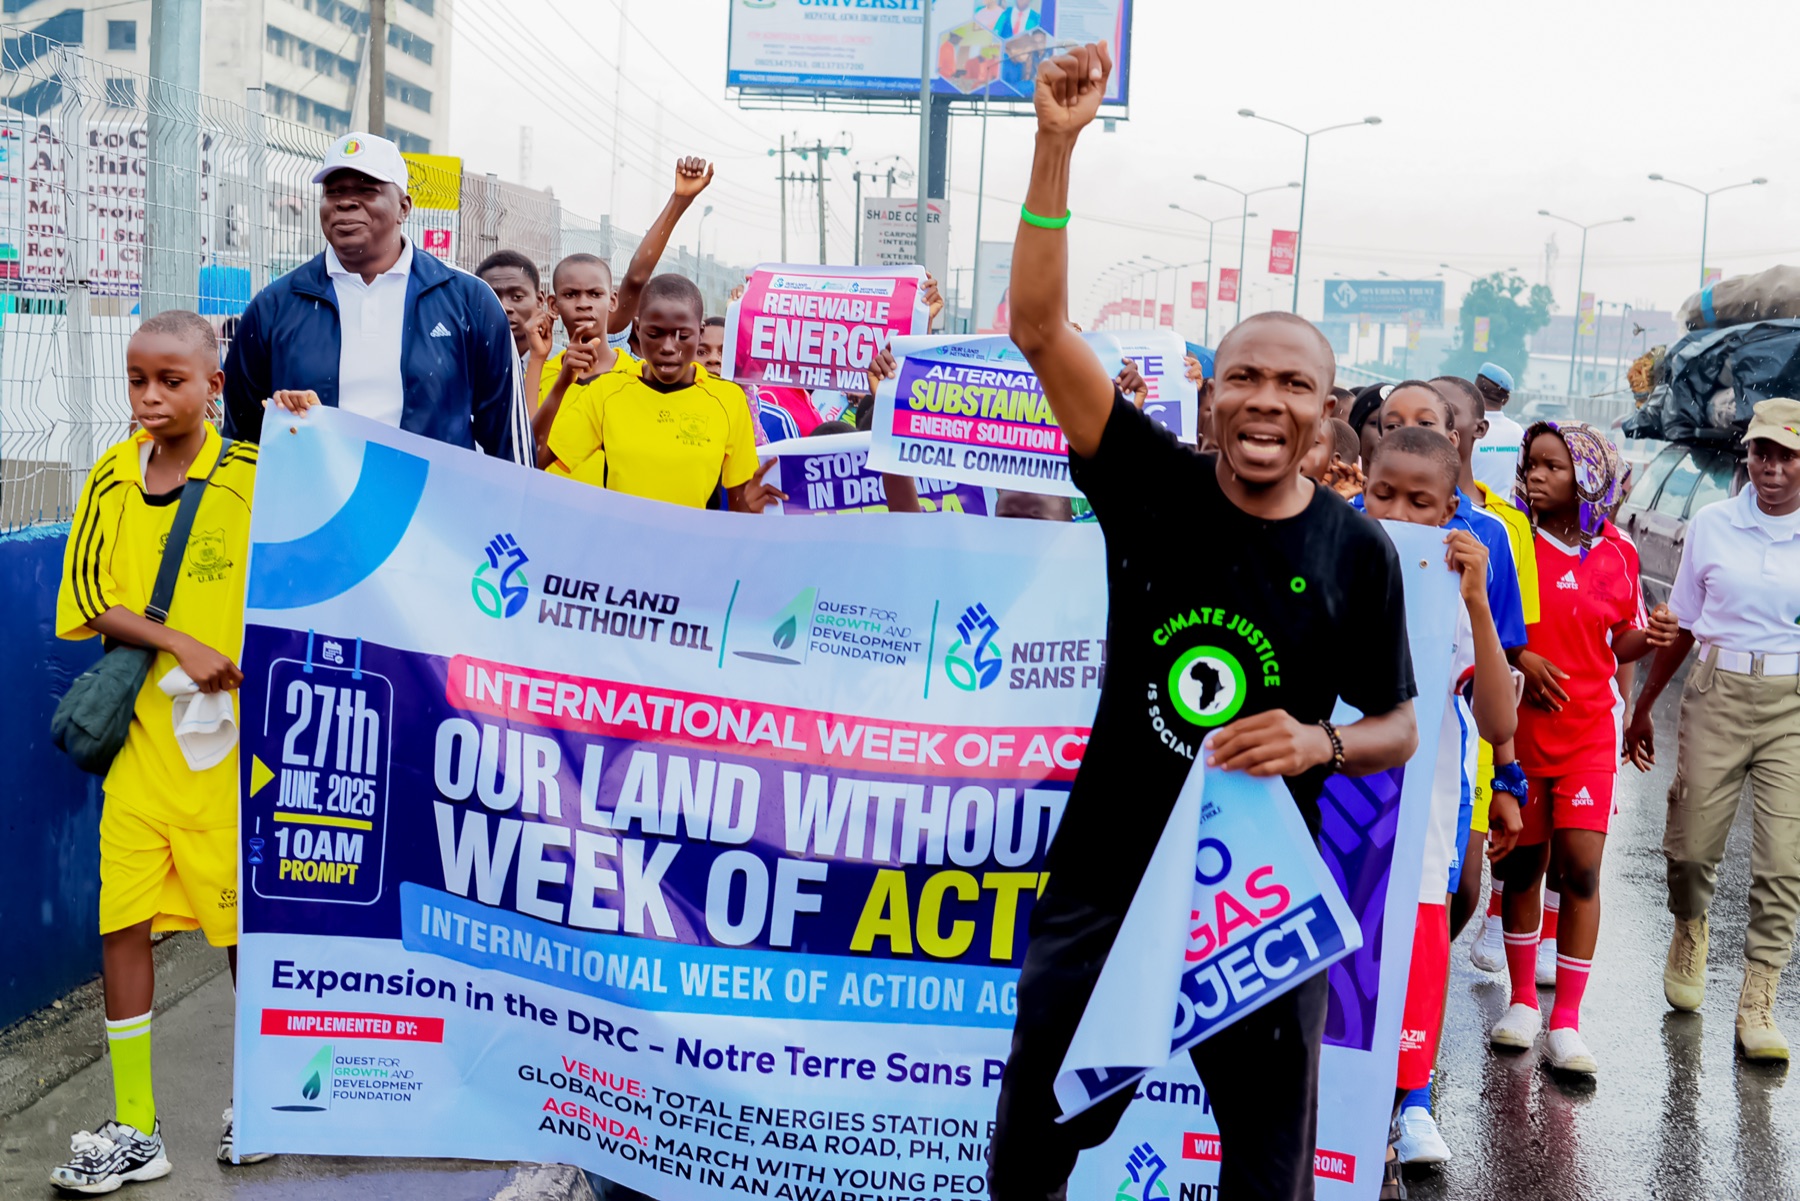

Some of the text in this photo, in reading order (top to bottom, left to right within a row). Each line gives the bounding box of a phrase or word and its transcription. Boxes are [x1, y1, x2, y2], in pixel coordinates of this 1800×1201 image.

[867, 210, 940, 223] SHADE COER
[763, 292, 890, 325] RENEWABLE
[751, 316, 899, 369] ENERGY
[763, 363, 793, 384] ALL
[799, 366, 834, 388] THE
[925, 364, 1041, 391] ALTERNAT
[910, 415, 971, 441] ENERGY
[976, 421, 1054, 451] SOLUTION
[899, 442, 1071, 482] LOCAL COMMUNIT
[807, 481, 835, 509] IN
[543, 574, 680, 615] OUR LAND
[818, 601, 898, 623] QUEST FOR
[538, 599, 713, 651] WITHOUT OIL
[812, 626, 922, 653] DEVELOPMENT
[815, 614, 912, 639] GROWTH AND
[810, 641, 907, 666] FOUNDATION
[1011, 639, 1090, 664] NOTRE
[1226, 614, 1280, 687] JUSTICE
[1009, 666, 1075, 690] SANS
[282, 680, 380, 776] 27th
[465, 664, 807, 751] INTERNATIONAL
[816, 719, 948, 766] WEEK
[954, 734, 1016, 767] OF
[1149, 705, 1194, 760] SOCIAL
[276, 768, 377, 816] JUNE, 2025
[434, 718, 562, 818] OUR
[580, 743, 761, 845] LAND
[274, 827, 364, 863] 10AM
[279, 859, 359, 885] PROMPT
[433, 800, 1051, 960] WEEK OF ACT
[421, 904, 667, 993] INTERNATIONAL
[680, 961, 773, 1001] WEEK
[785, 969, 828, 1004] OF
[839, 972, 966, 1012] ACTION
[272, 960, 456, 1003] Expansion
[466, 981, 494, 1011] in
[504, 993, 558, 1026] the
[567, 1010, 639, 1053] DRC
[675, 1037, 776, 1075] Notre
[784, 1045, 876, 1081] Terre
[886, 1053, 972, 1087] Sans
[287, 1016, 418, 1036] IMPLEMENTED BY:
[1400, 1029, 1426, 1043] AZIN
[334, 1067, 414, 1079] GROWTH AND
[335, 1056, 400, 1067] QUEST FOR
[333, 1091, 411, 1102] FOUNDATION
[334, 1079, 423, 1091] DEVELOPMENT
[561, 1055, 646, 1099] VENUE:
[651, 1086, 729, 1120] TOTAL
[739, 1105, 866, 1132] ENERGIES
[872, 1114, 979, 1139] STATION
[518, 1064, 653, 1121] GLOBACOM
[659, 1109, 755, 1147] OFFICE,
[761, 1130, 819, 1153] ABA
[824, 1135, 902, 1161] ROAD,
[909, 1140, 950, 1163] PH,
[538, 1115, 592, 1143] AND
[596, 1132, 692, 1182] WOMEN
[699, 1167, 725, 1188] IN
[730, 1175, 770, 1197] AN
[542, 1097, 649, 1147] AGENDA:
[655, 1134, 749, 1172] MARCH
[756, 1157, 825, 1183] WITH
[833, 1168, 926, 1192] YOUNG
